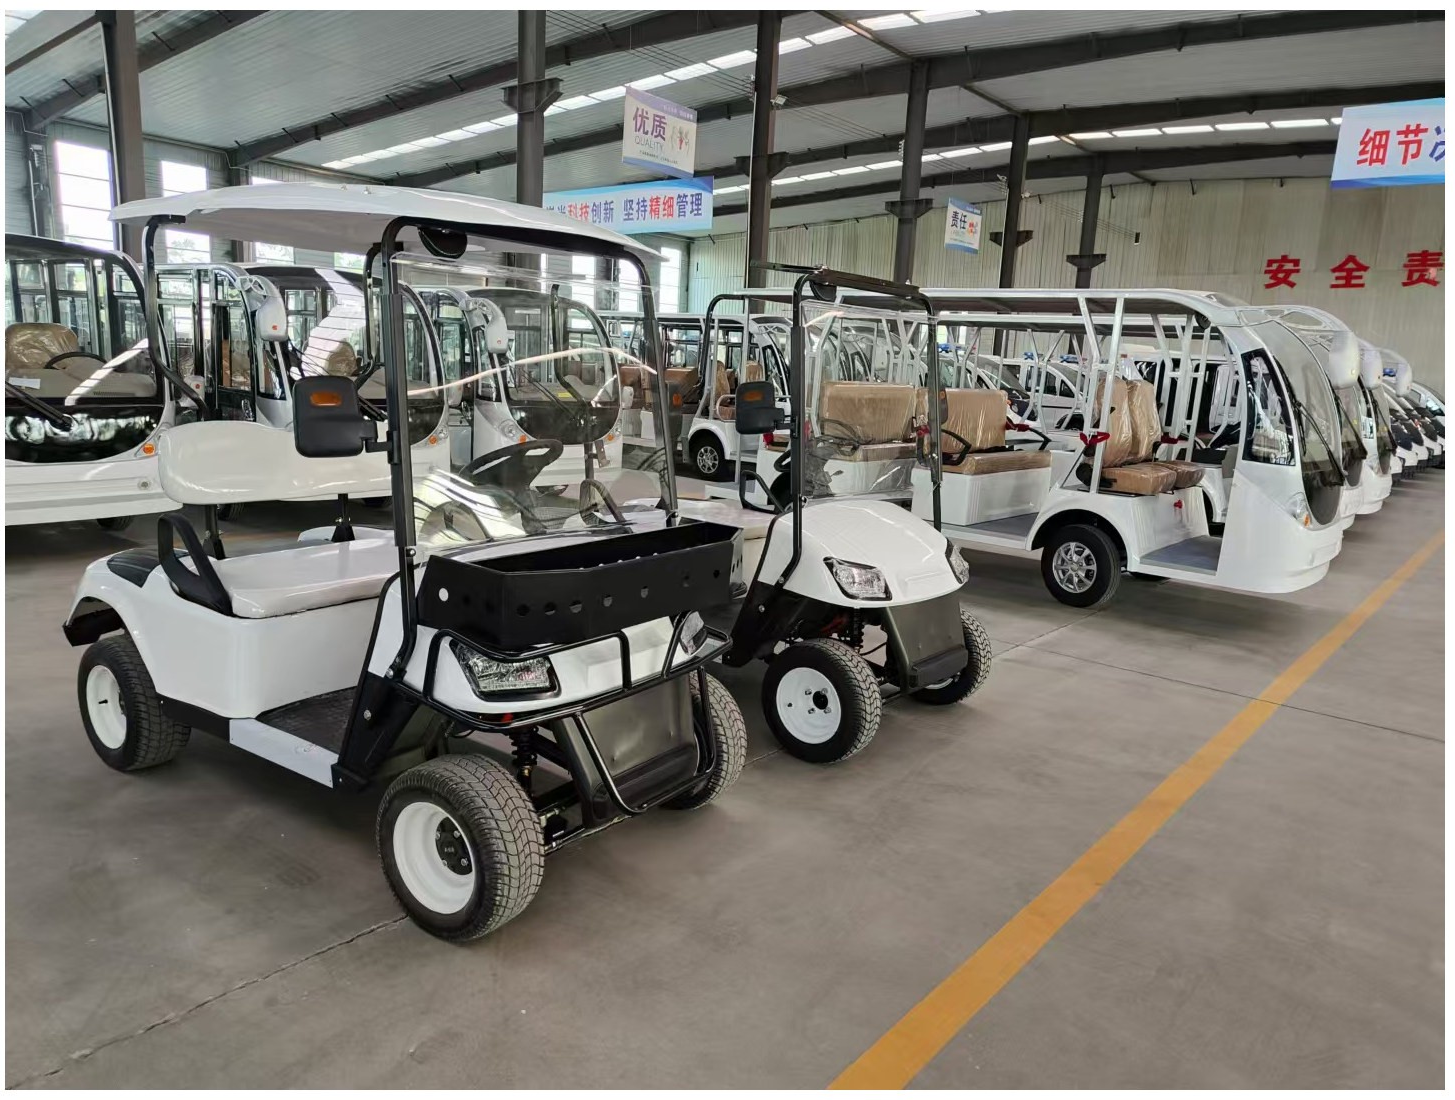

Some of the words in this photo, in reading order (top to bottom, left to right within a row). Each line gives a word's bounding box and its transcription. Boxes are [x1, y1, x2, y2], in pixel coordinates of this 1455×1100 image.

[633, 107, 667, 141] 优质
[635, 136, 664, 151] QUALITY
[546, 200, 614, 224] 科技创新
[623, 193, 703, 222] 坚持精细管理
[951, 210, 967, 229] 责任
